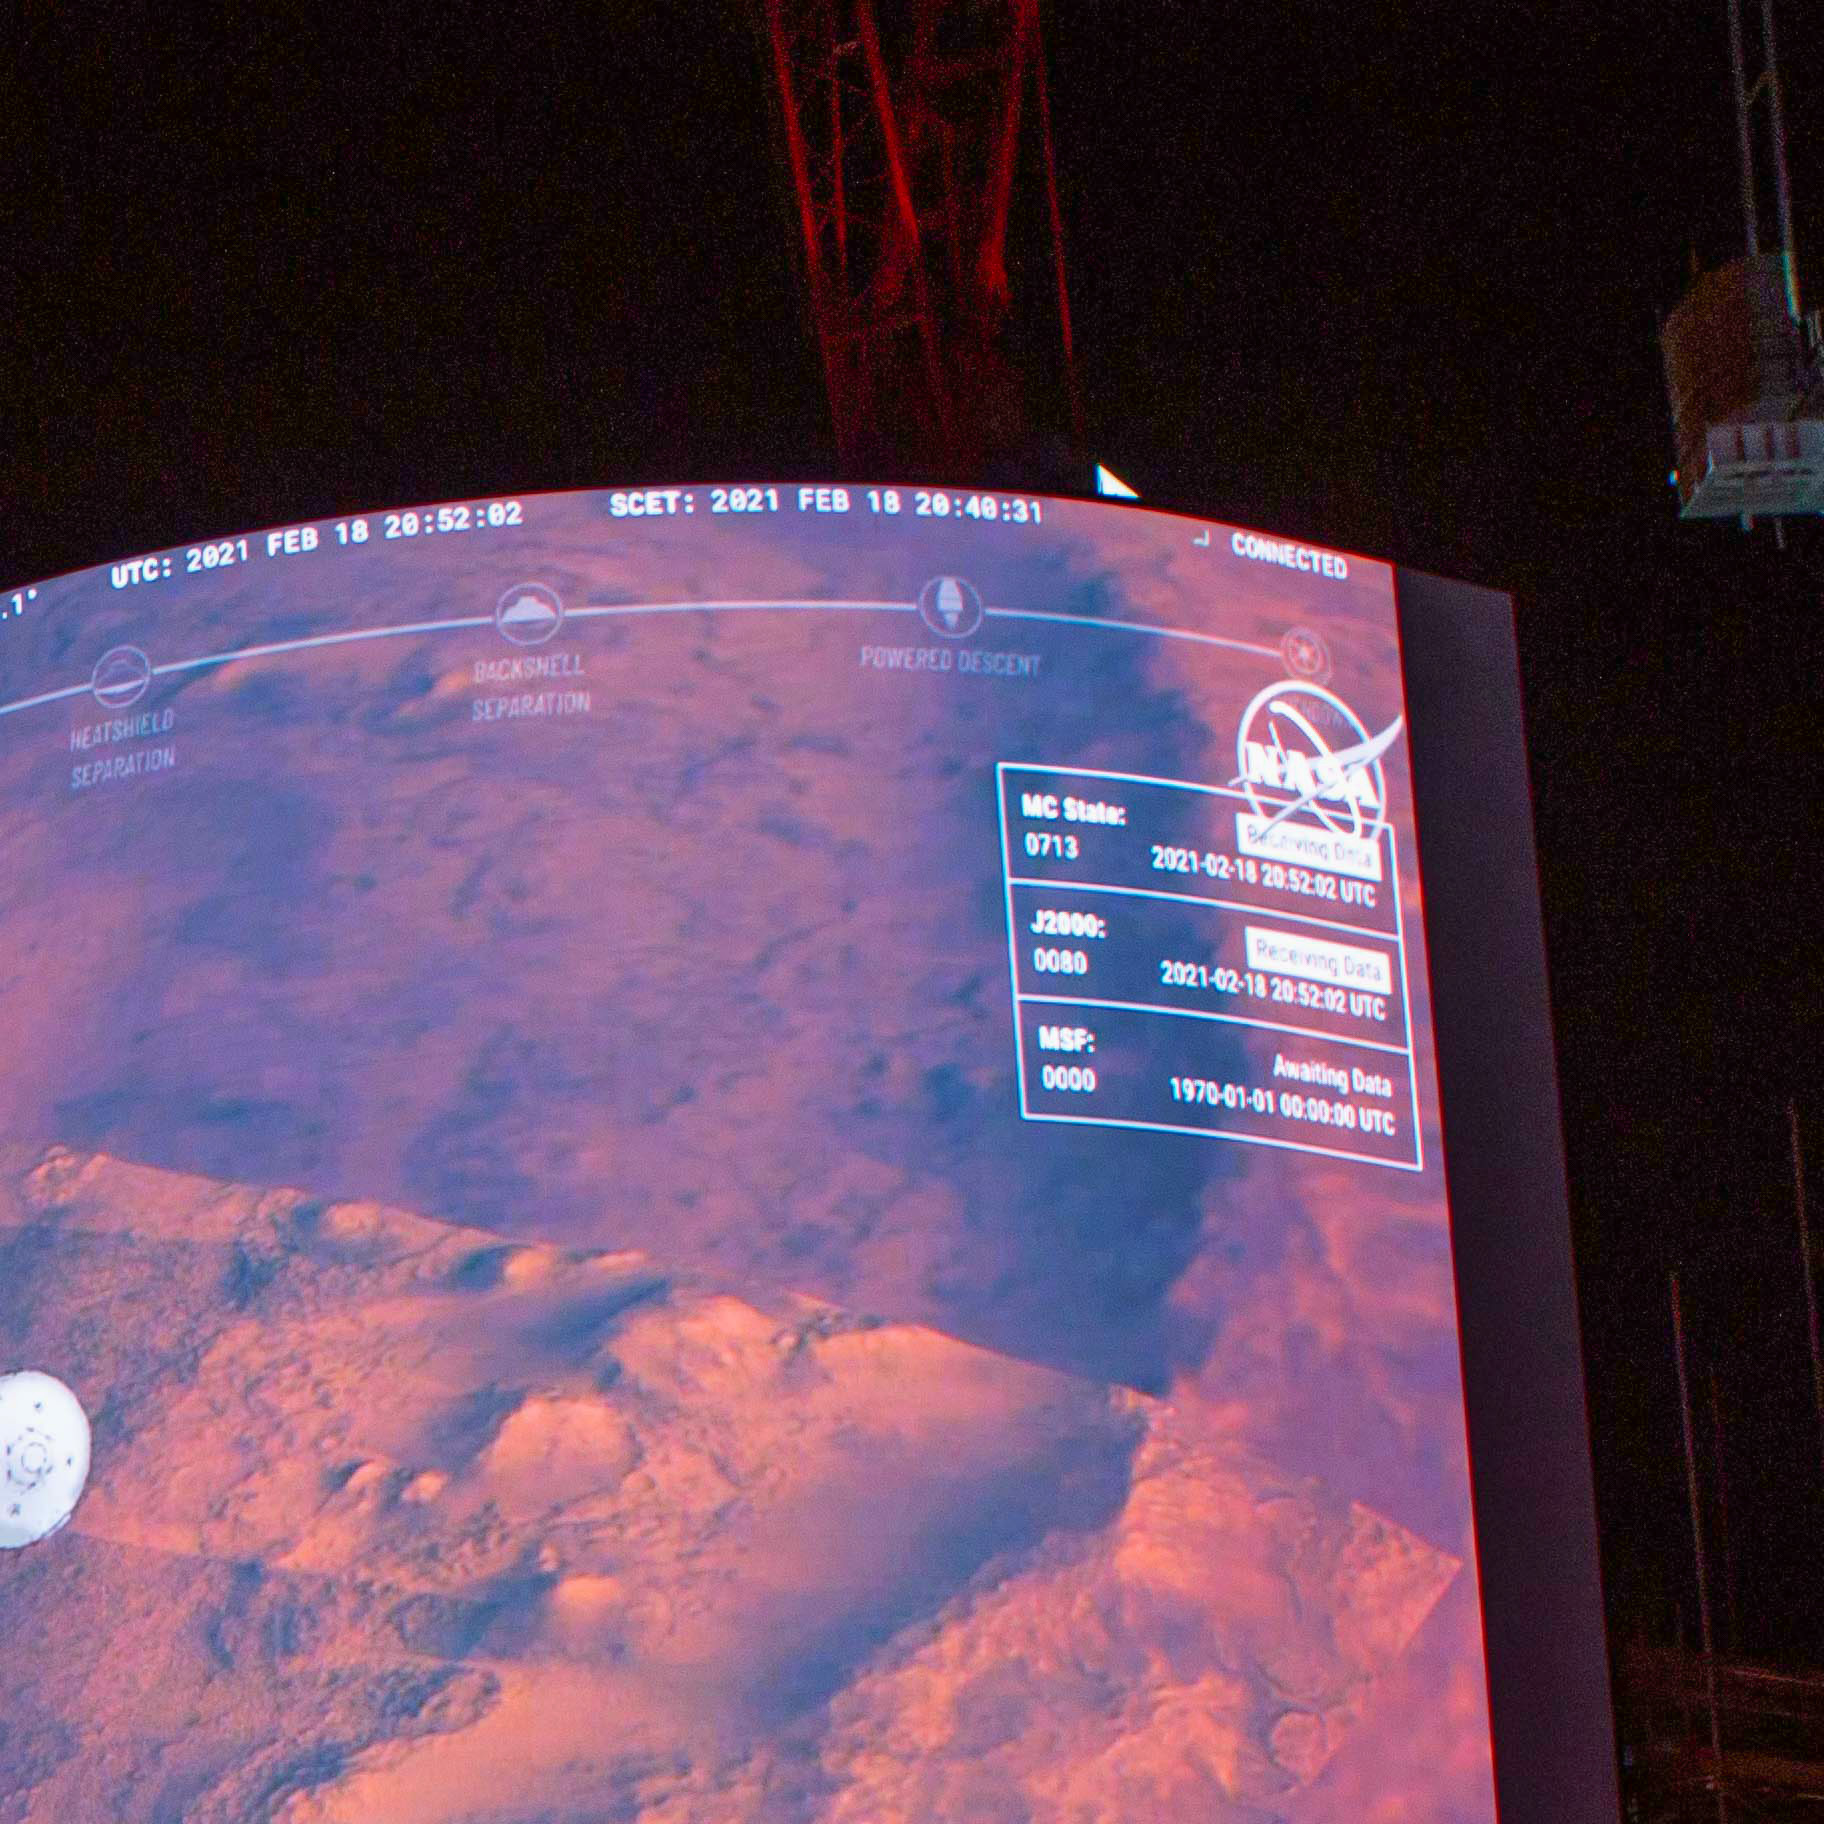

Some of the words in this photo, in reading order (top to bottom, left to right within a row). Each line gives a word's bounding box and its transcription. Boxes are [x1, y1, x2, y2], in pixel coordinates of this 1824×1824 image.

[111, 557, 172, 590] UTC:
[186, 538, 248, 574] 2021
[267, 527, 319, 557] FEB
[335, 519, 368, 545] 18
[384, 501, 523, 540] 20:52:02
[610, 490, 697, 517] SCET:
[711, 488, 779, 513] 2021
[799, 488, 850, 513] FEB
[867, 490, 900, 515] 18
[915, 492, 1044, 526] 20:40:31
[1231, 531, 1349, 581] CONNECTED
[474, 653, 585, 685] BACKSHELL
[861, 645, 952, 672] POWERED
[957, 648, 1043, 679] DESCENT
[472, 690, 591, 721] SEPARATION
[70, 707, 175, 752] HEATSHIELD
[71, 746, 176, 790] SEPARATION
[1245, 740, 1381, 810] NASA
[1021, 793, 1059, 819] MC
[1062, 796, 1129, 826] State:
[1024, 832, 1079, 859] 0713
[1151, 845, 1257, 884] 2021-02-18
[1261, 864, 1337, 900] 20:52:02
[1340, 882, 1376, 908] UTC
[1031, 909, 1108, 939] J2000:
[1256, 938, 1338, 978] Receiving
[1344, 955, 1384, 981] Data
[1160, 960, 1267, 999] 2021-02-18
[1271, 978, 1347, 1015] 20:52:02
[1350, 995, 1387, 1022] UTC
[1038, 1025, 1096, 1054] MSF:
[1042, 1064, 1096, 1093] 0000
[1273, 1053, 1349, 1095] Awaiting
[1352, 1067, 1393, 1099] Data
[1170, 1076, 1274, 1114] 1970-01-01
[1279, 1092, 1356, 1129] 00:00:00
[1359, 1107, 1396, 1137] UTC
